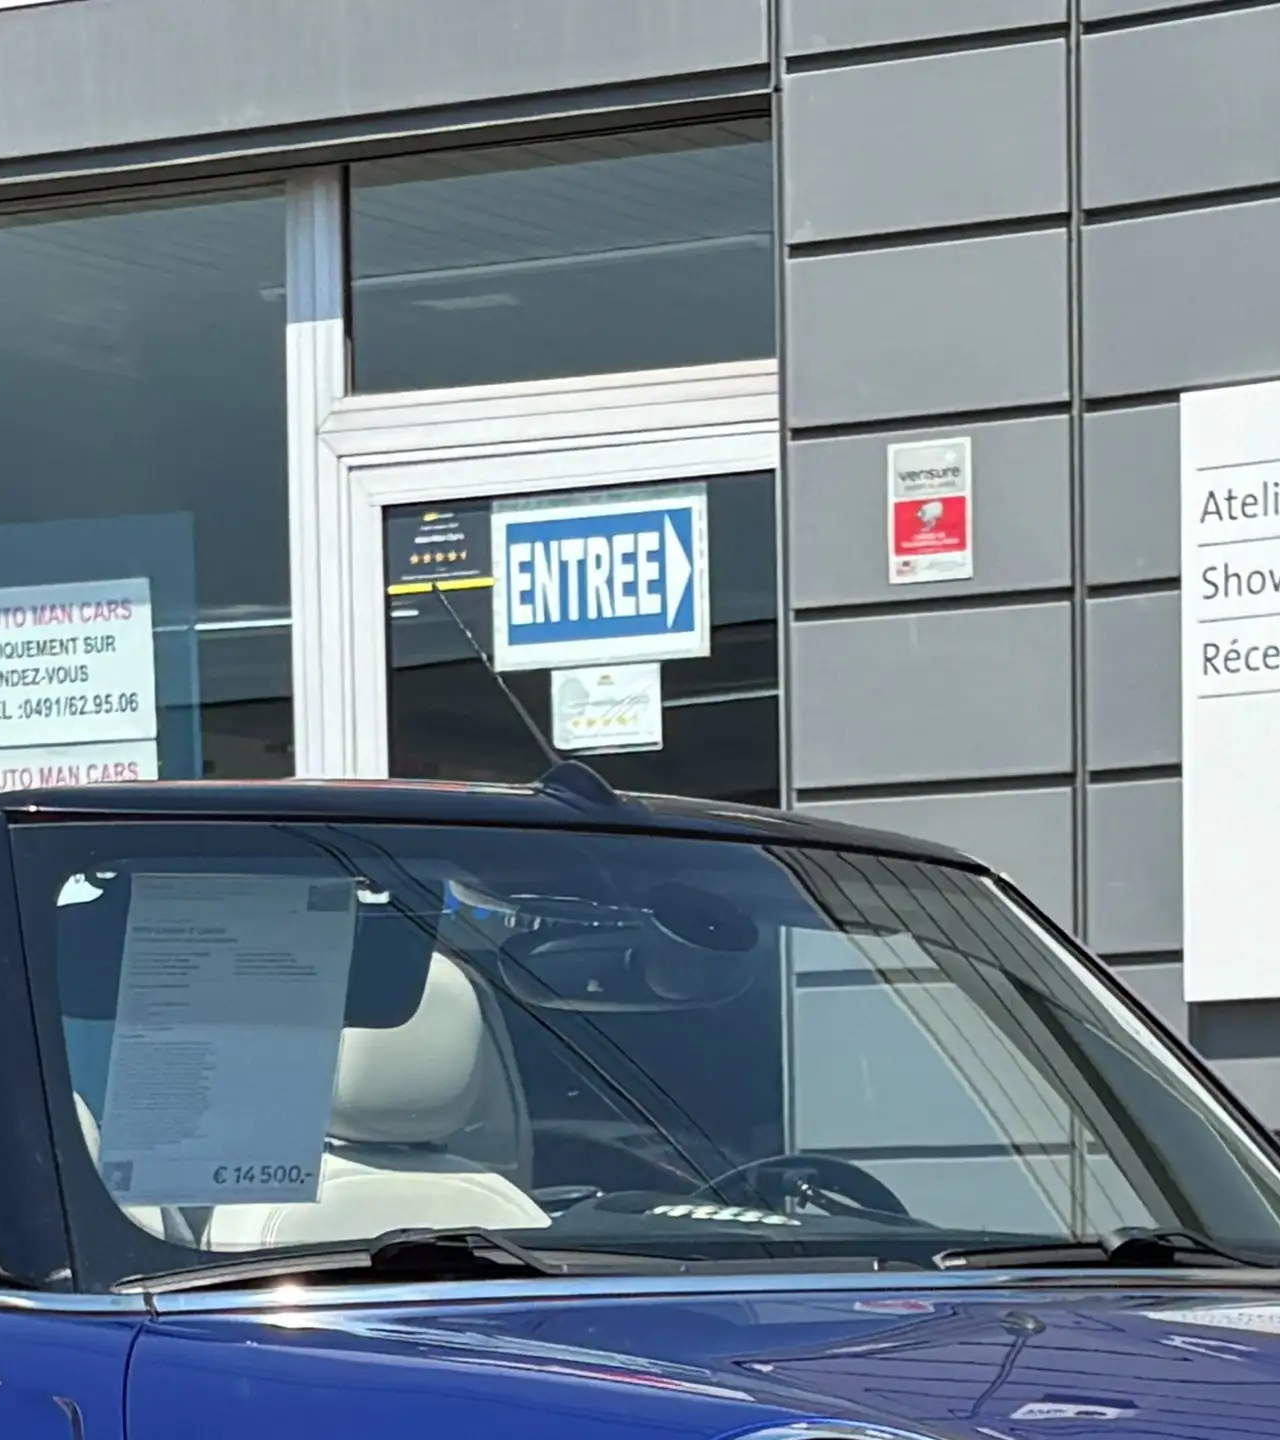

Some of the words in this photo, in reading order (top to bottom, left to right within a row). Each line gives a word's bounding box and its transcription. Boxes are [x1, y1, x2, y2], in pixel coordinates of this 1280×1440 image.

[509, 531, 662, 626] ENTREE
[31, 602, 73, 626] MAN
[79, 599, 132, 623] CARS
[83, 635, 116, 654] SUR
[39, 765, 80, 785] MAN
[86, 761, 138, 784] CARS
